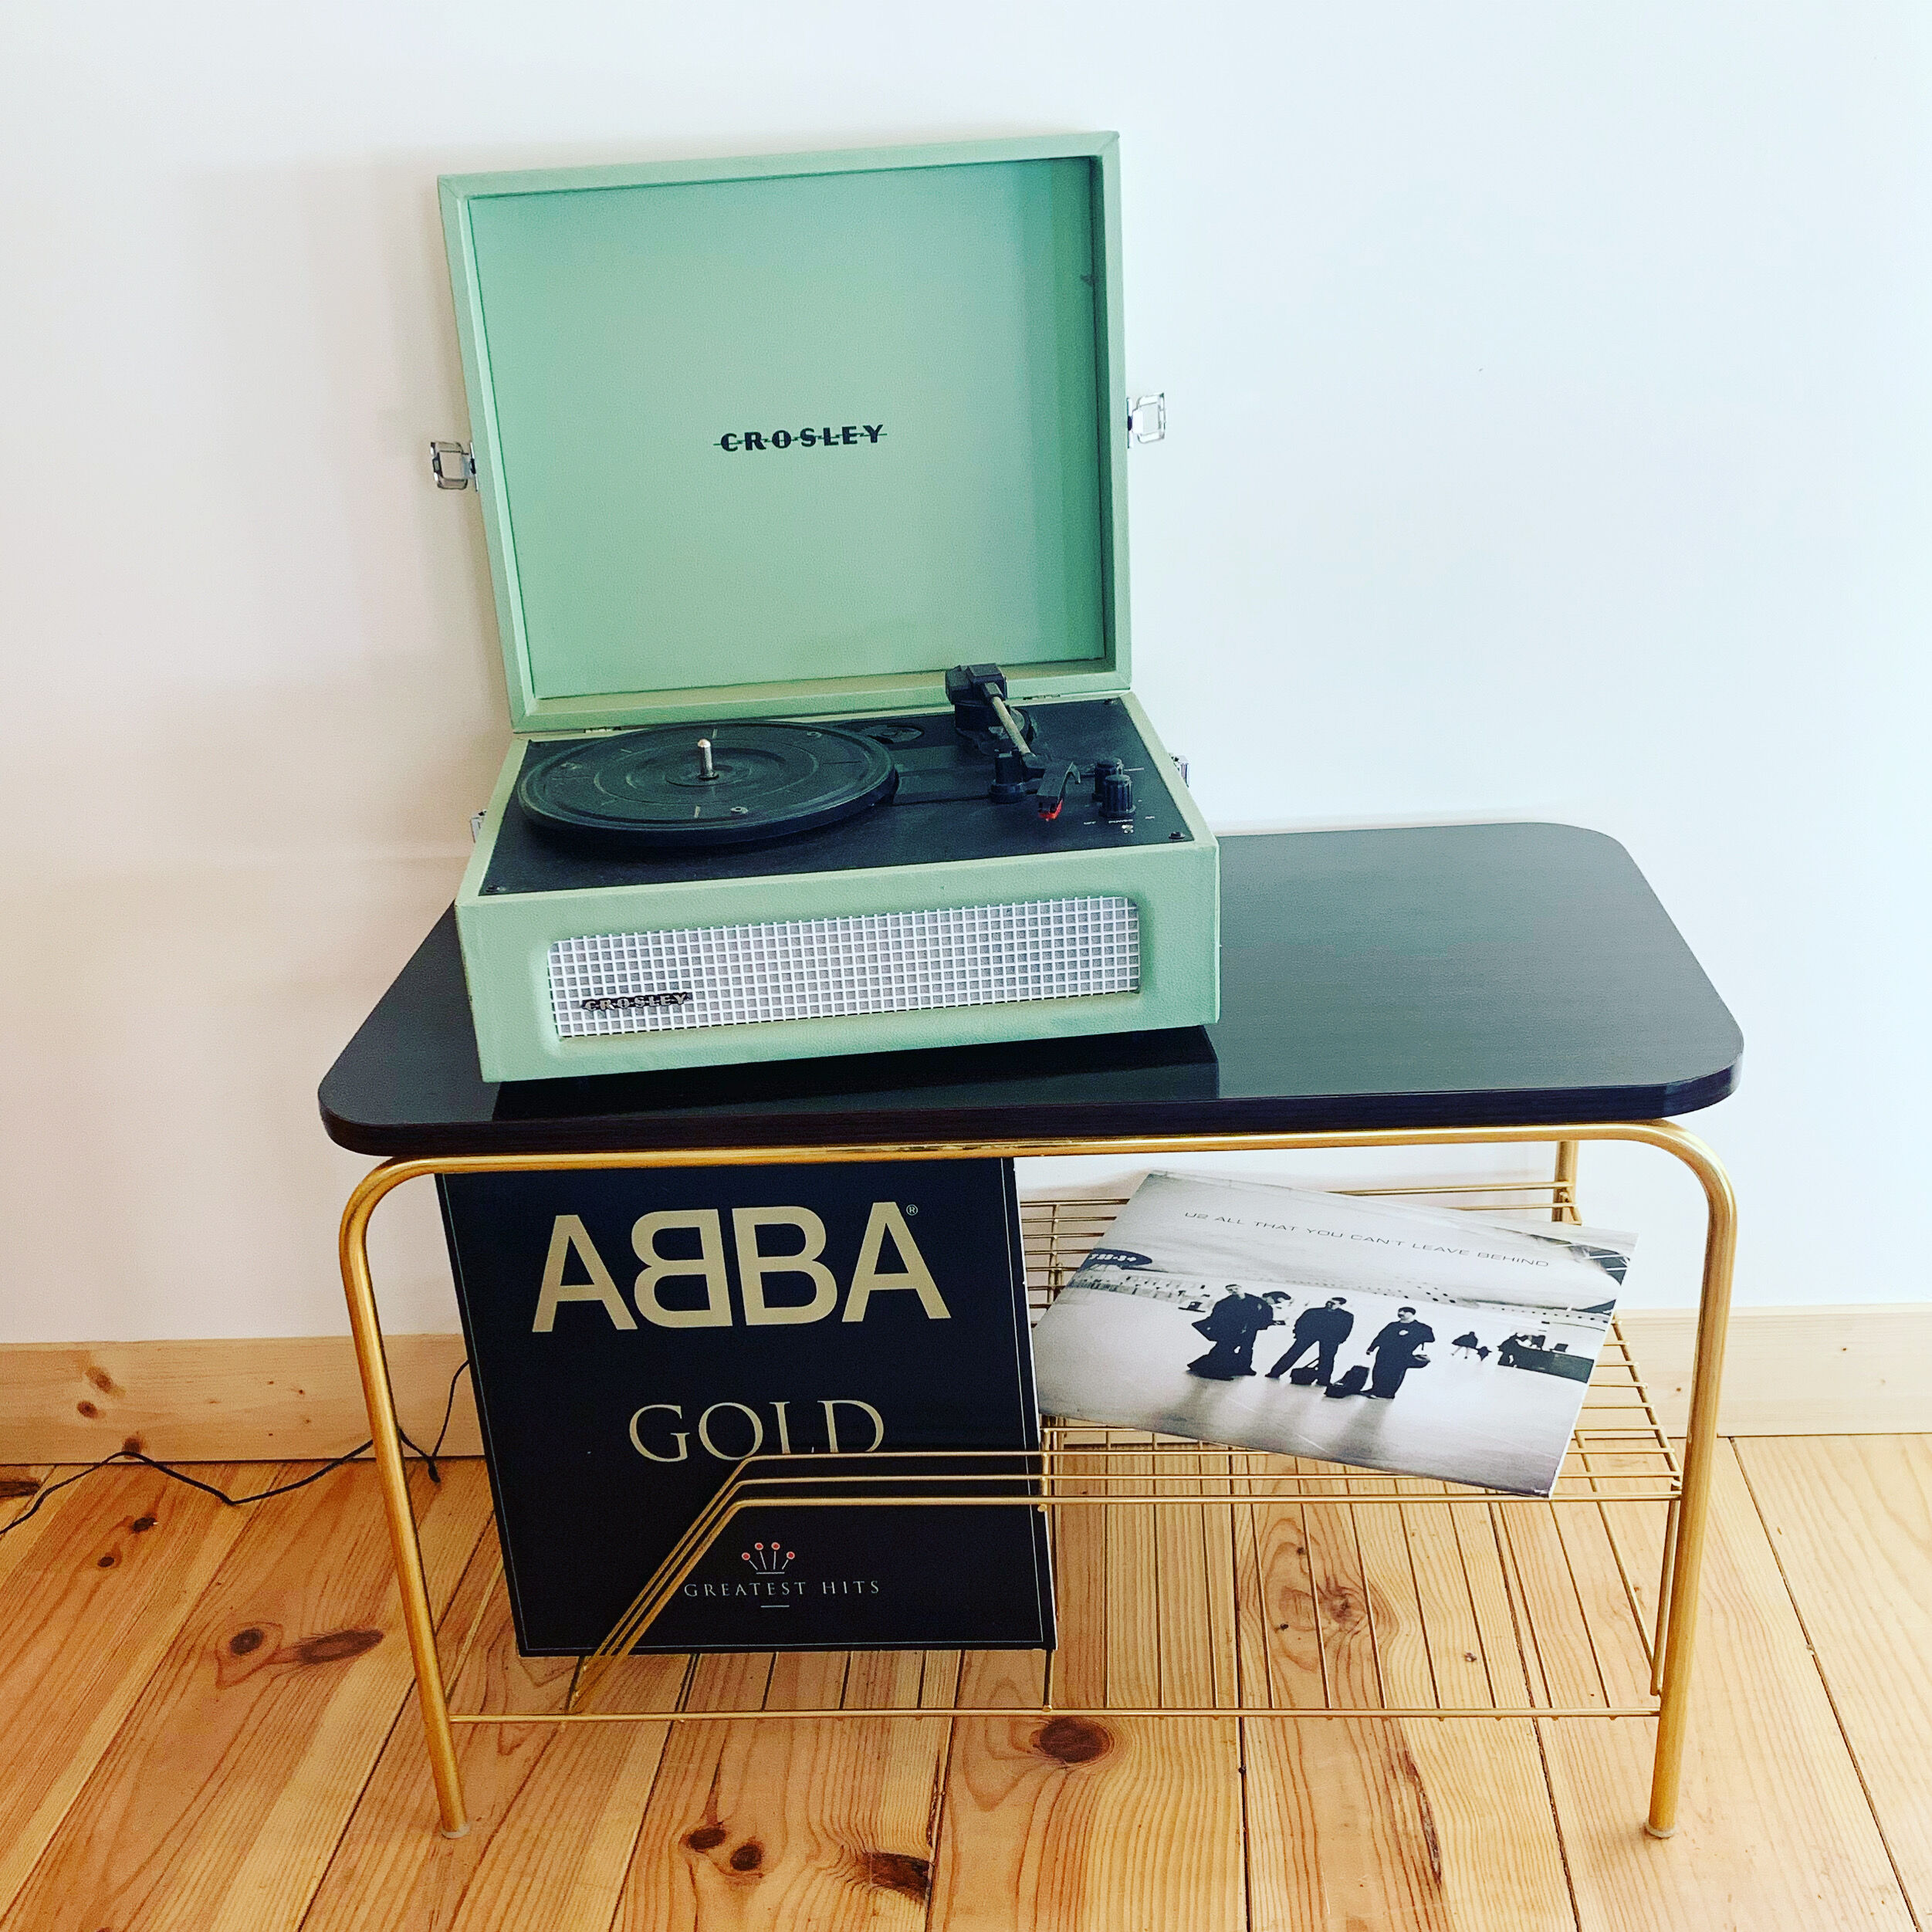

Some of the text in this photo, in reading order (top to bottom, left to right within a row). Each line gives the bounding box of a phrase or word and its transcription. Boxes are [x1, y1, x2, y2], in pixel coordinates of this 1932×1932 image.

[719, 424, 885, 452] CROSLEY
[584, 992, 686, 1011] CROSLEY
[1185, 1211, 1550, 1267] U2 ALL THAT YOU CAN'T LEAVE BEHIND
[531, 1201, 952, 1333] ABBA
[628, 1399, 885, 1463] GOLD
[683, 1580, 880, 1597] GREATEST HITS
